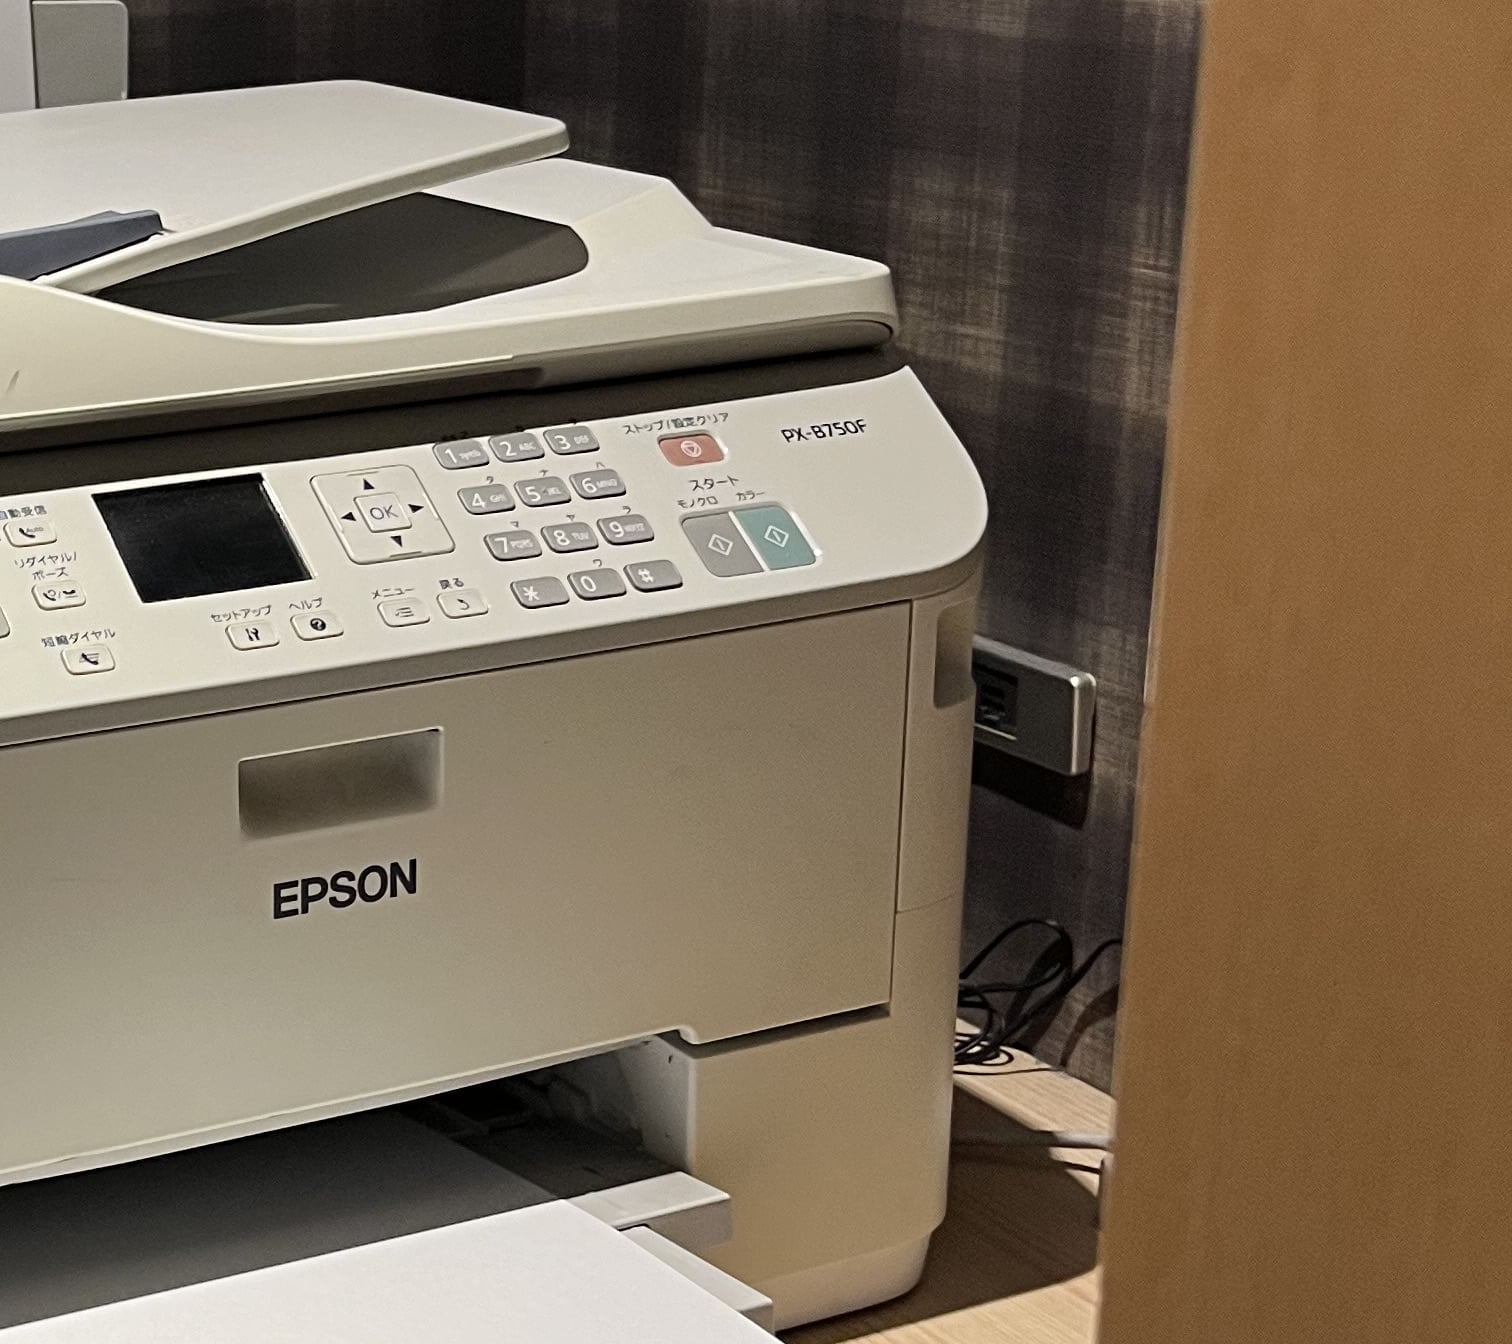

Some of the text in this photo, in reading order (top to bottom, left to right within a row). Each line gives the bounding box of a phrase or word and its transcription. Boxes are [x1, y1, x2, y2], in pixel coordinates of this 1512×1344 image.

[780, 418, 868, 443] PX-B750F
[499, 441, 517, 456] 2
[554, 435, 571, 449] 3
[445, 448, 457, 463] 1
[582, 478, 597, 493] 6
[688, 475, 740, 492] スタート
[472, 493, 486, 509] 4
[525, 486, 541, 501] 5
[736, 490, 766, 501] カラー
[677, 495, 719, 509] モノクロ
[369, 504, 400, 521] OK
[609, 521, 624, 537] 9
[494, 537, 508, 553] 7
[553, 530, 570, 545] 8
[580, 576, 596, 592] 0
[371, 587, 416, 599] メニュー
[288, 597, 324, 610] ヘルプ
[210, 604, 273, 623] セットアップ
[273, 858, 417, 919] EPSON
